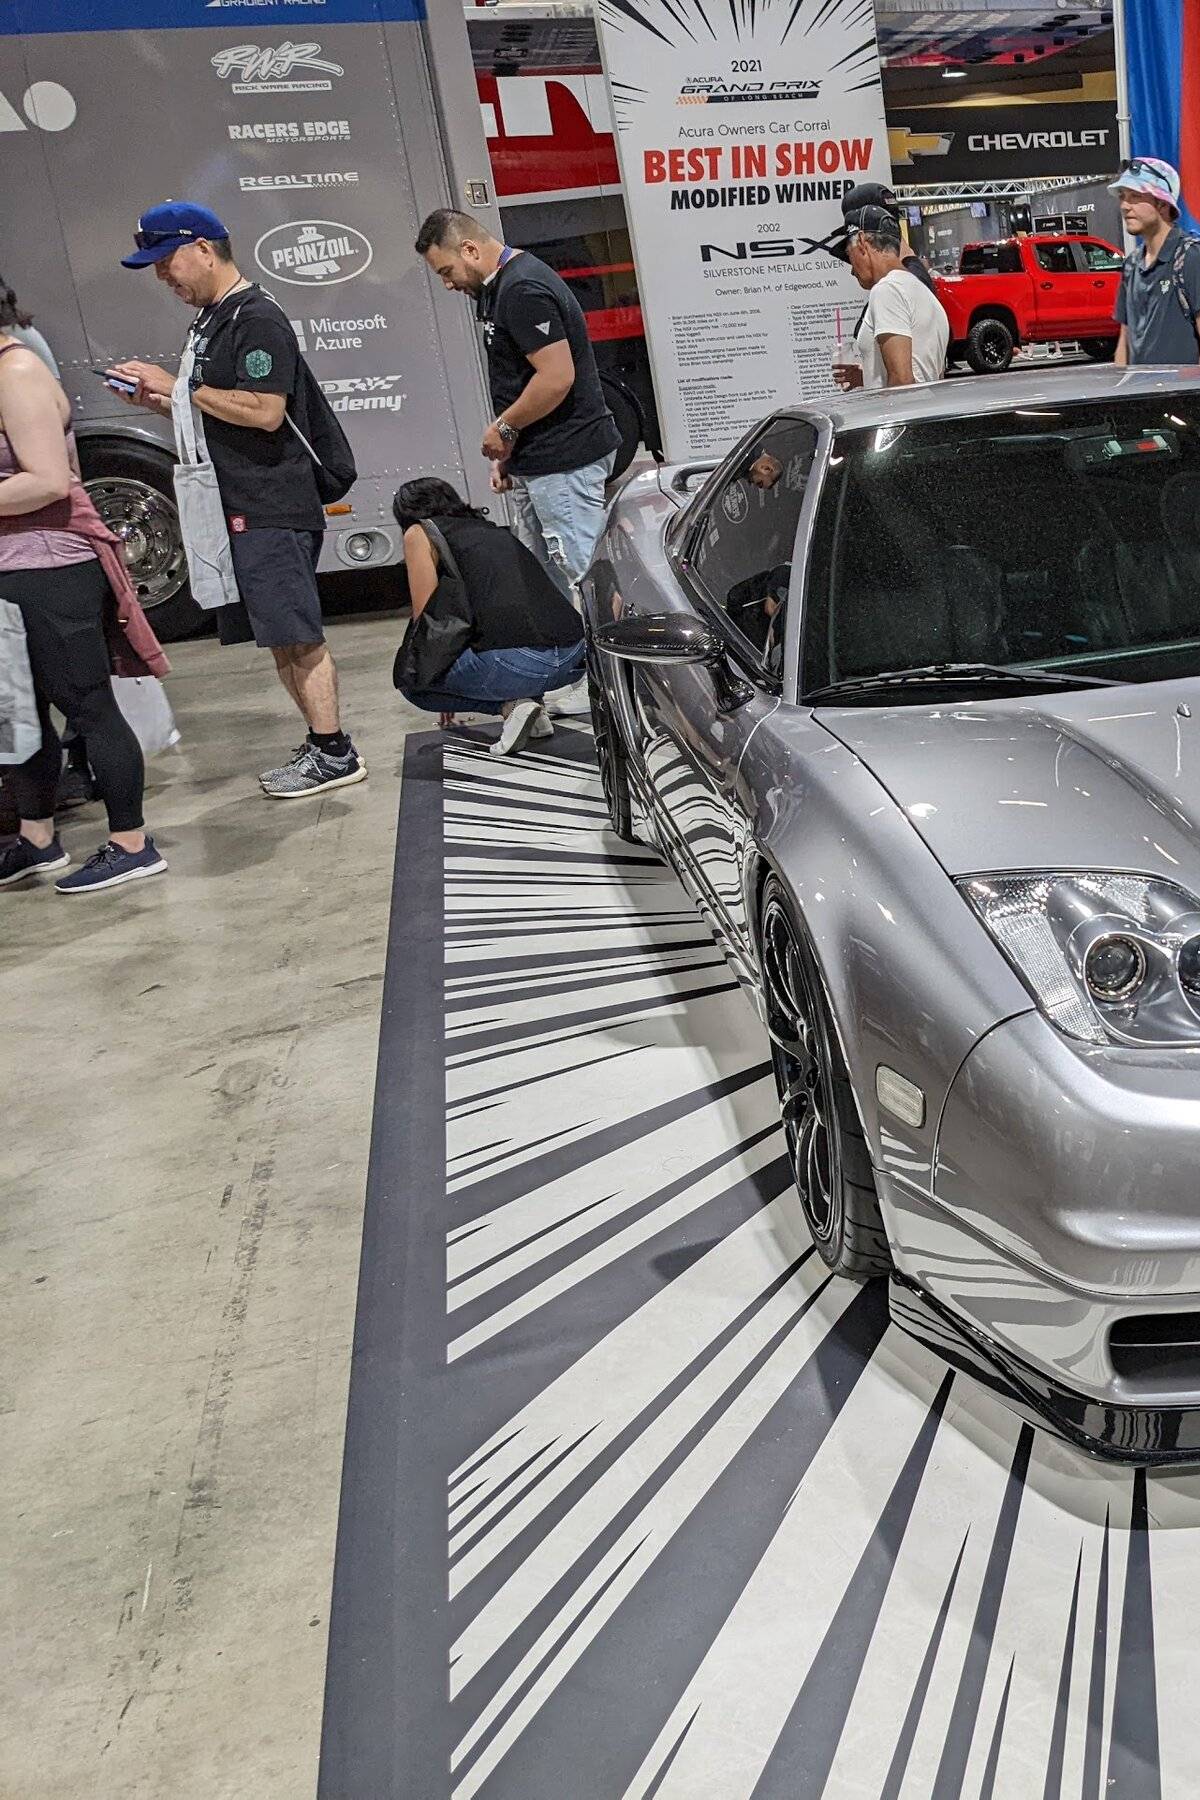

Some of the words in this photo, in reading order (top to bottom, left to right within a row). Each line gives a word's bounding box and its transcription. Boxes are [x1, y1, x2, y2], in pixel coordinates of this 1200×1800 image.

[731, 59, 762, 73] 2021
[680, 82, 764, 94] GRAND
[769, 79, 823, 91] PRIX
[692, 76, 724, 84] ACURA
[773, 92, 804, 100] BEACH
[228, 122, 300, 139] RACERS
[303, 120, 350, 136] EDGE
[678, 126, 714, 138] Acura
[718, 124, 766, 136] Owners
[769, 122, 790, 133] Car
[794, 119, 831, 132] Corral
[266, 135, 351, 143] MOTORSPORTS
[968, 130, 1110, 151] CHEVROLET
[644, 147, 723, 184] BEST
[731, 144, 767, 180] IN
[775, 138, 874, 177] SHOW
[238, 172, 360, 187] REALTIME
[670, 182, 770, 211] MODIFIED
[757, 223, 781, 233] 2002
[271, 236, 355, 270] PENNZOIL
[700, 236, 838, 262] NSX
[703, 266, 765, 279] SILVERSTONE
[767, 262, 812, 275] METALLIC
[715, 288, 742, 296] Owner:
[744, 286, 762, 294] Brian
[763, 285, 774, 293] M.
[784, 281, 824, 292] Edgewood,
[825, 280, 839, 288] WA
[310, 314, 388, 334] Microsoft
[315, 336, 362, 351] Azure
